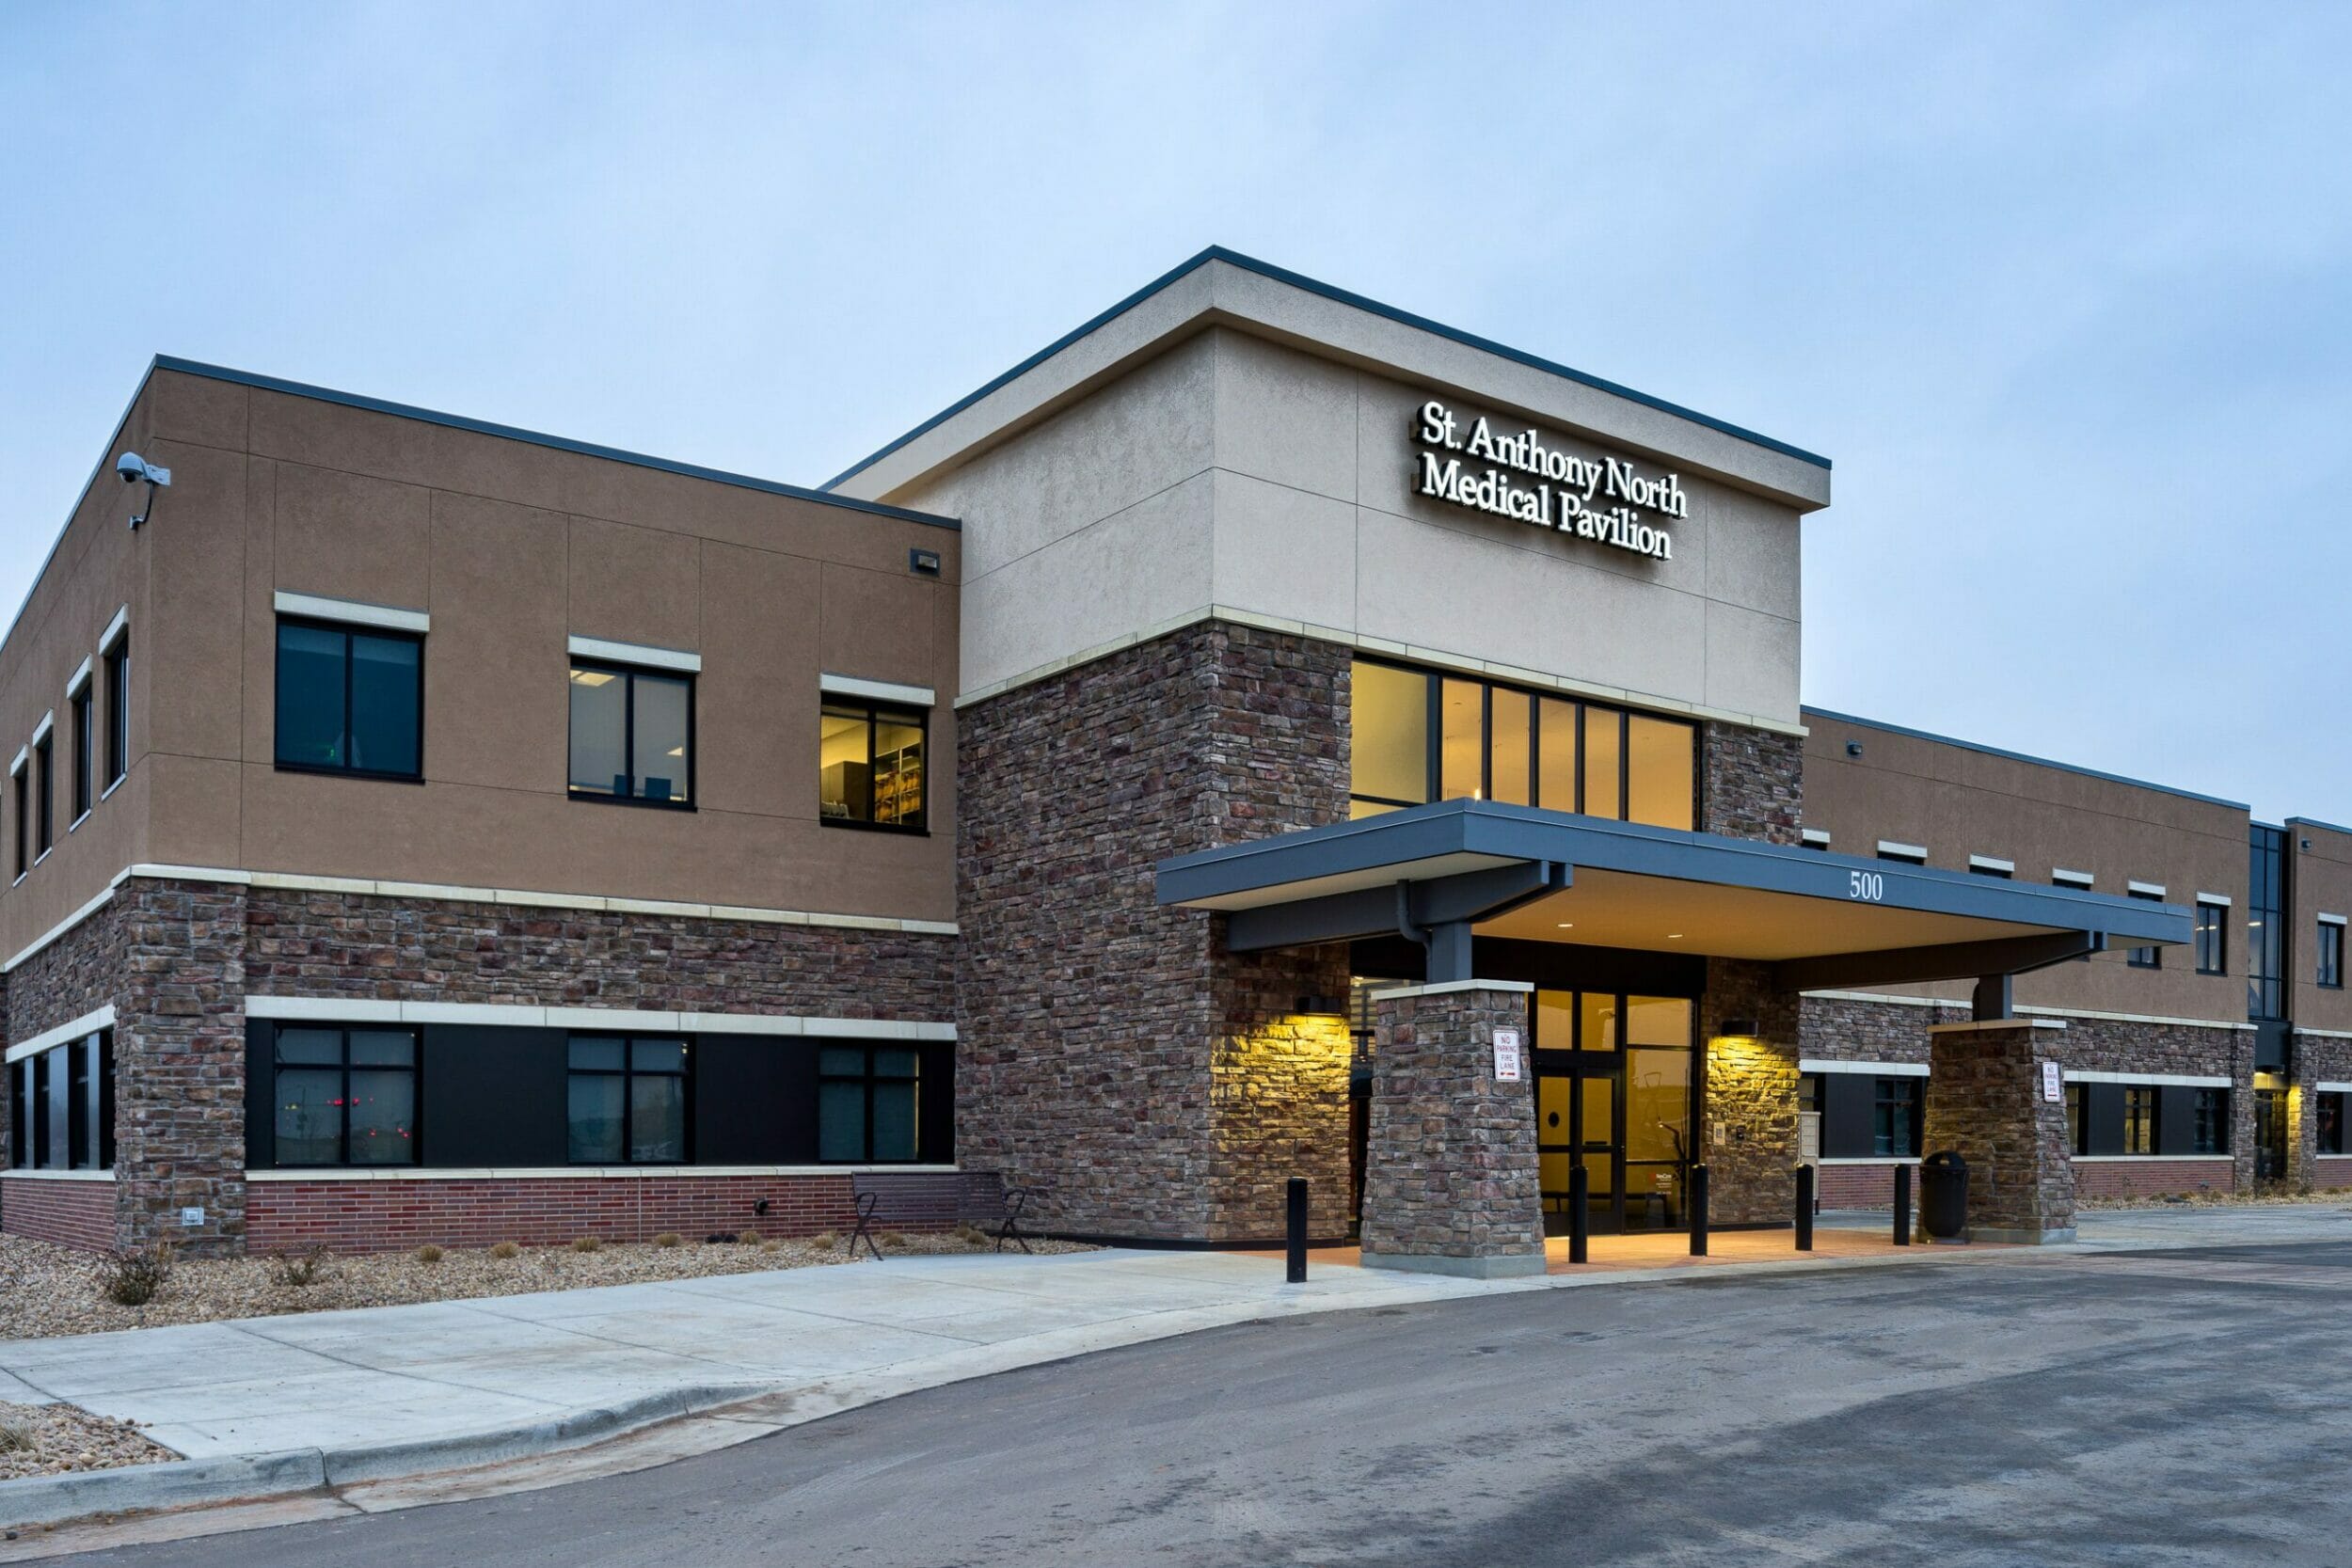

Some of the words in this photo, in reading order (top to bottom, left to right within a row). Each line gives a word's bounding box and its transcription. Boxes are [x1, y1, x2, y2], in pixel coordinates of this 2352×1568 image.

[1422, 401, 1462, 450] St.
[1466, 417, 1602, 501] Anthony
[1600, 456, 1688, 518] North
[1421, 451, 1551, 527] Medical
[1558, 490, 1672, 560] Pavilion
[1850, 871, 1883, 900] 500
[1497, 1045, 1517, 1053] PARKING
[1501, 1036, 1511, 1044] NO
[1501, 1053, 1513, 1062] FIRE
